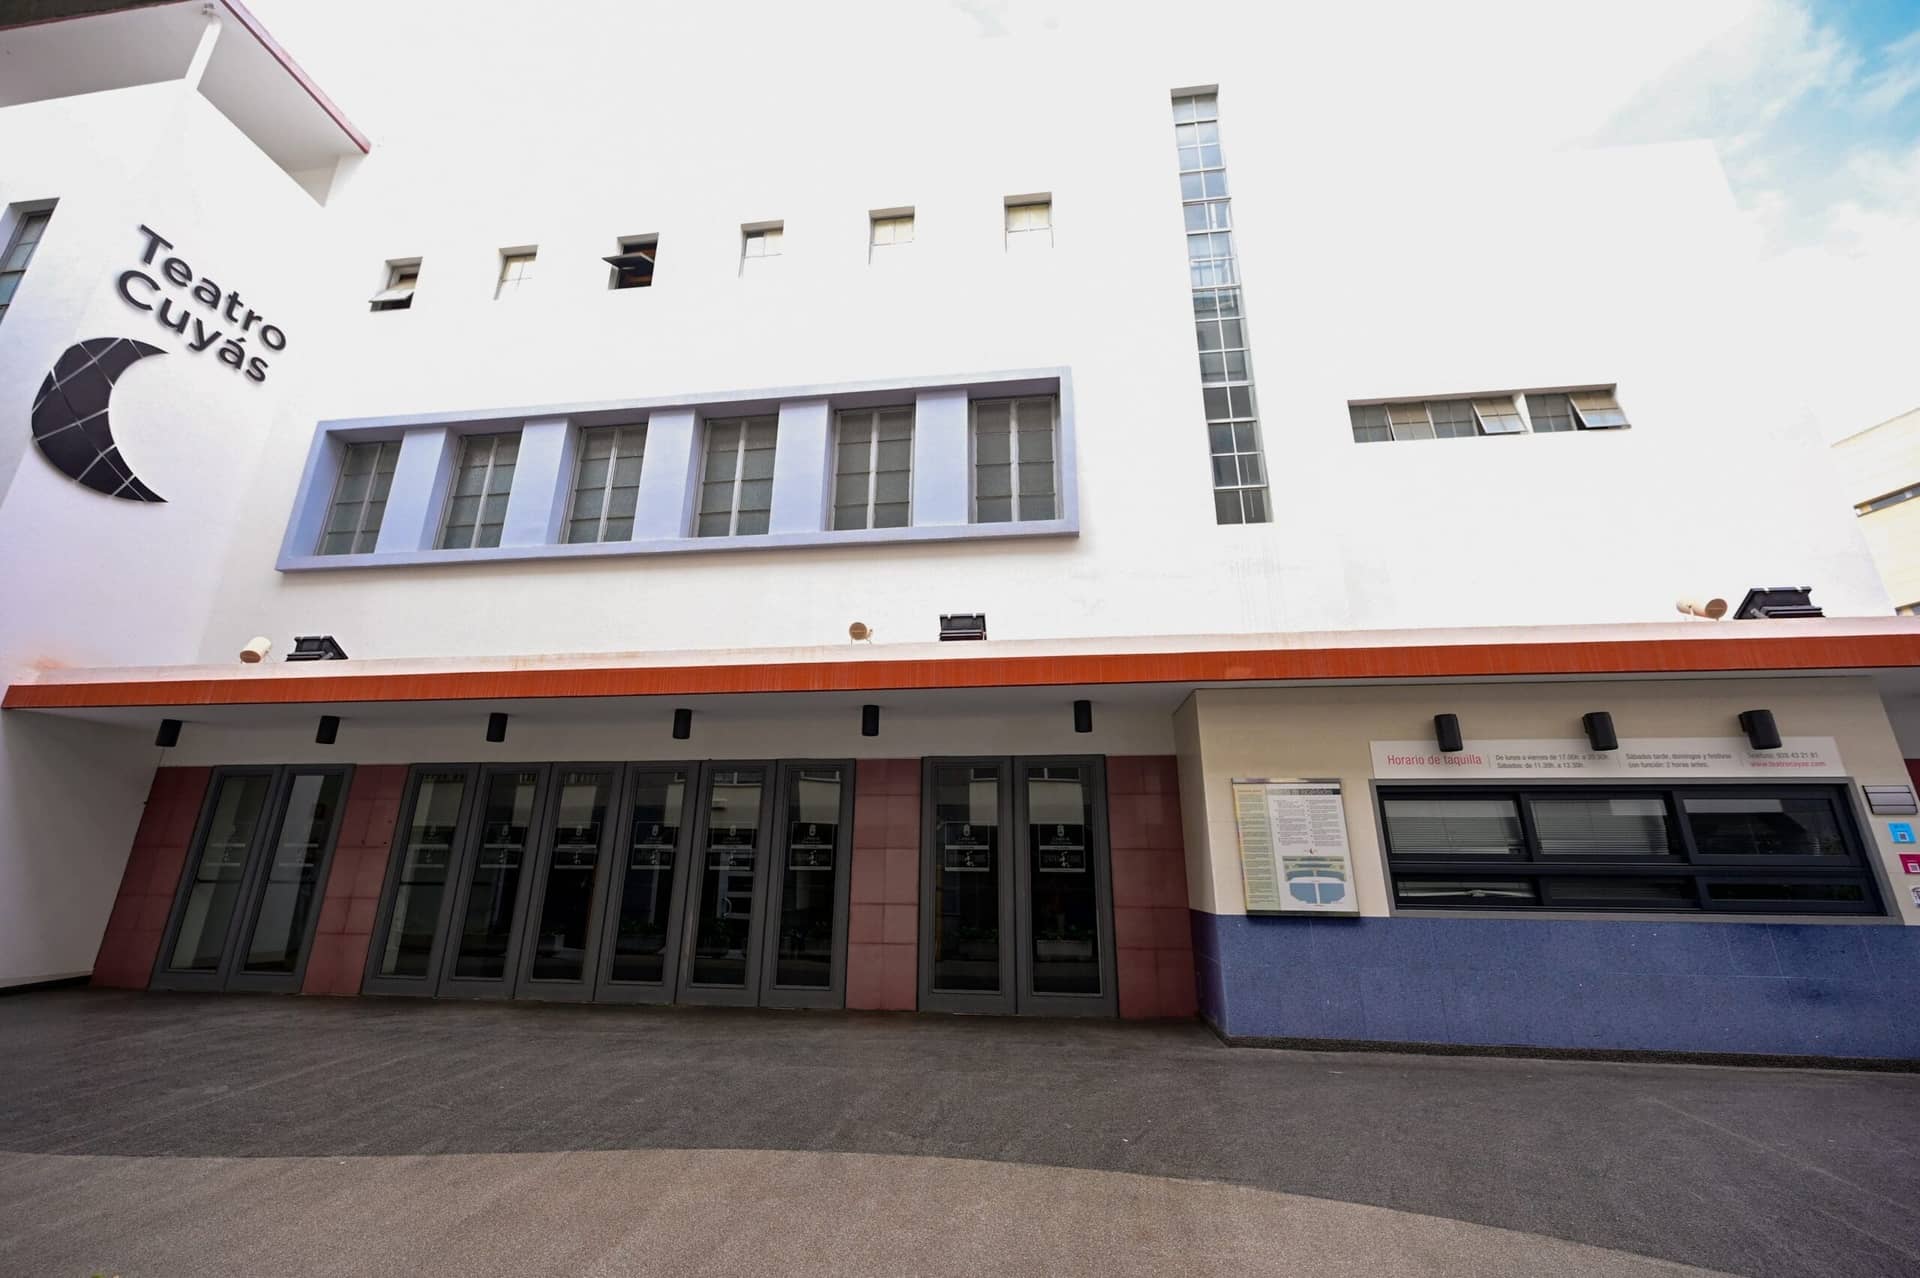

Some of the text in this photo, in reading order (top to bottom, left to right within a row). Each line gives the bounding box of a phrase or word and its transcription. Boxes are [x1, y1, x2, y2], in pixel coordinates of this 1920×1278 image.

[117, 269, 270, 384] Cuyás
[139, 224, 287, 352] Teatro
[1387, 754, 1482, 767] Horario de taquilla
